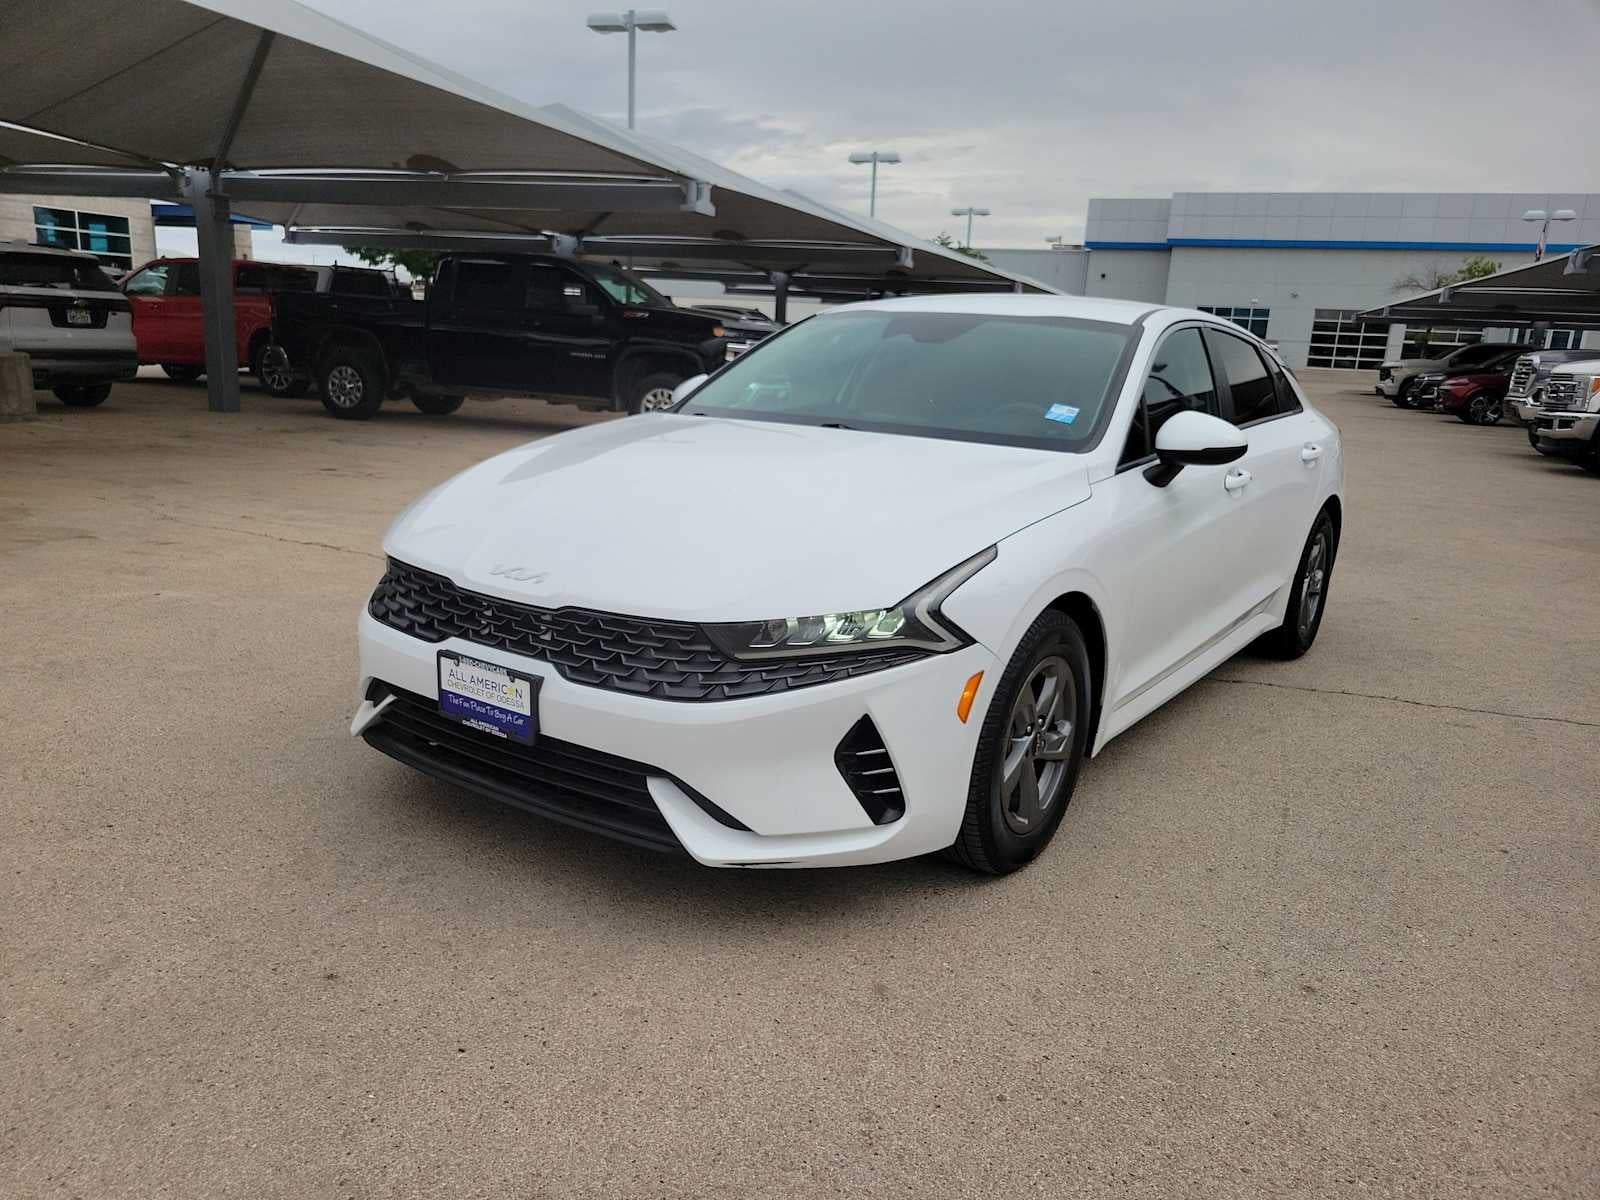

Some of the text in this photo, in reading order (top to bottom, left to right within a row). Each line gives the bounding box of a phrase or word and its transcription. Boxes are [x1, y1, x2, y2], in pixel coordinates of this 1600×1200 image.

[449, 668, 467, 683] ALL
[447, 679, 485, 697] CHEVROLET
[507, 713, 513, 723] A
